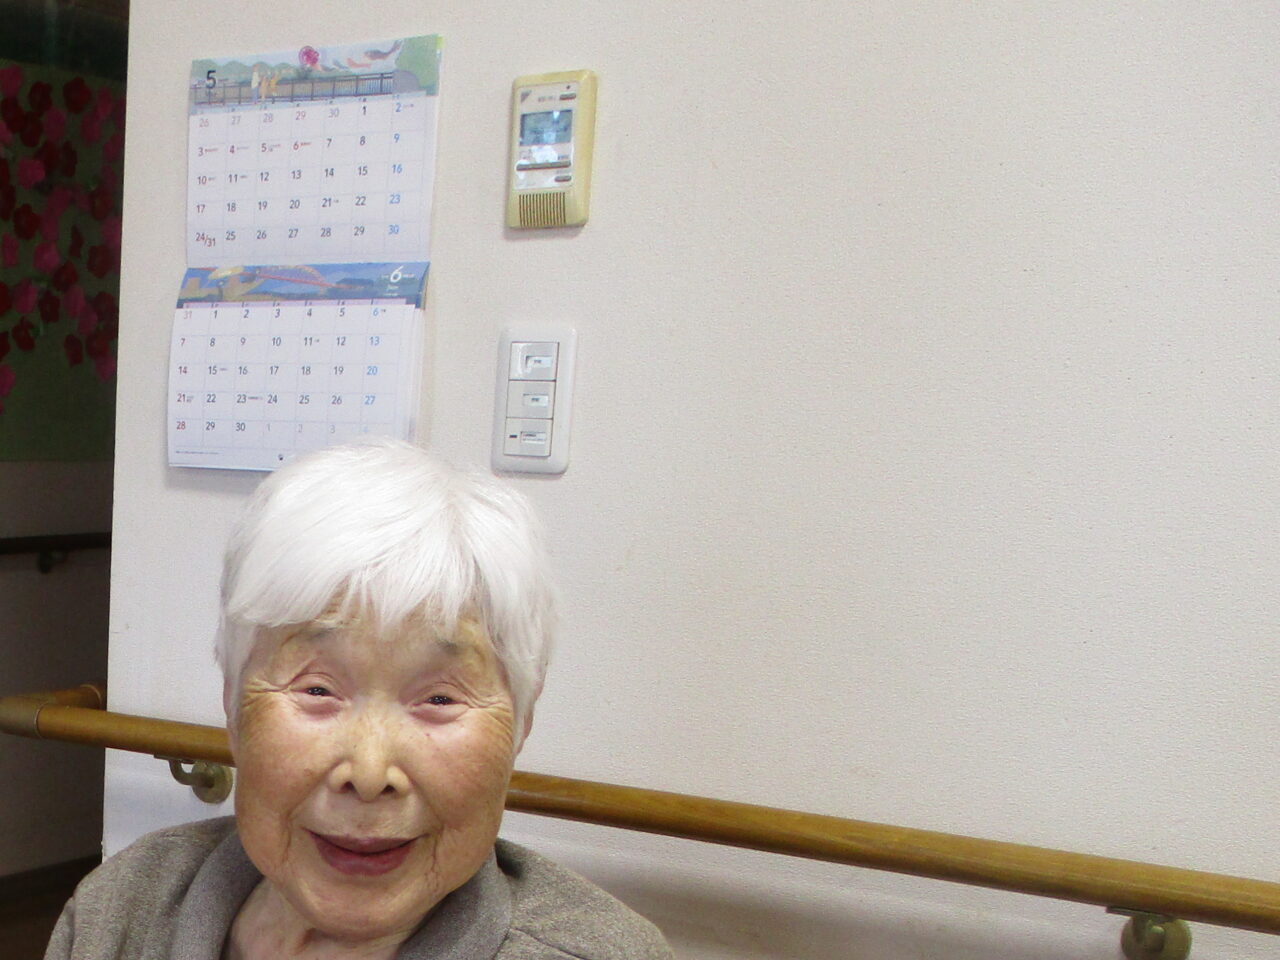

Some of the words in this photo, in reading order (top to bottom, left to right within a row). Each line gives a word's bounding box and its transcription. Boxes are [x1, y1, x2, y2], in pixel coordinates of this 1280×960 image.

[206, 69, 216, 89] 5
[197, 176, 207, 185] 10
[228, 174, 238, 183] 11
[260, 172, 269, 181] 12
[292, 170, 302, 179] 13
[324, 168, 334, 177] 14
[358, 166, 368, 176] 15
[392, 164, 402, 174] 16
[196, 204, 205, 213] 17
[226, 201, 236, 212] 18
[258, 201, 268, 210] 19
[289, 200, 300, 209] 20
[322, 198, 332, 207] 21
[355, 196, 366, 206] 22
[389, 194, 400, 204] 23
[196, 232, 216, 247] 24/31
[226, 231, 236, 241] 25
[257, 230, 266, 240] 26
[288, 228, 298, 238] 27
[320, 228, 331, 237] 28
[354, 226, 364, 236] 29
[388, 224, 399, 235] 30
[390, 265, 404, 283] 6
[272, 337, 281, 346] 10
[304, 337, 312, 346] 11
[336, 336, 346, 346] 12
[369, 336, 380, 346] 13
[178, 366, 187, 374] 14
[208, 366, 217, 375] 15
[238, 366, 247, 375] 16
[270, 366, 279, 375] 17
[301, 366, 311, 375] 18
[334, 366, 344, 375] 19
[367, 366, 378, 375] 20
[177, 394, 186, 402] 21
[206, 394, 216, 403] 22
[236, 394, 247, 403] 23
[267, 395, 277, 404] 24
[299, 395, 310, 404] 25
[332, 395, 342, 405] 26
[364, 395, 375, 405] 27
[176, 421, 186, 430] 28
[206, 422, 215, 430] 29
[235, 422, 246, 431] 30
